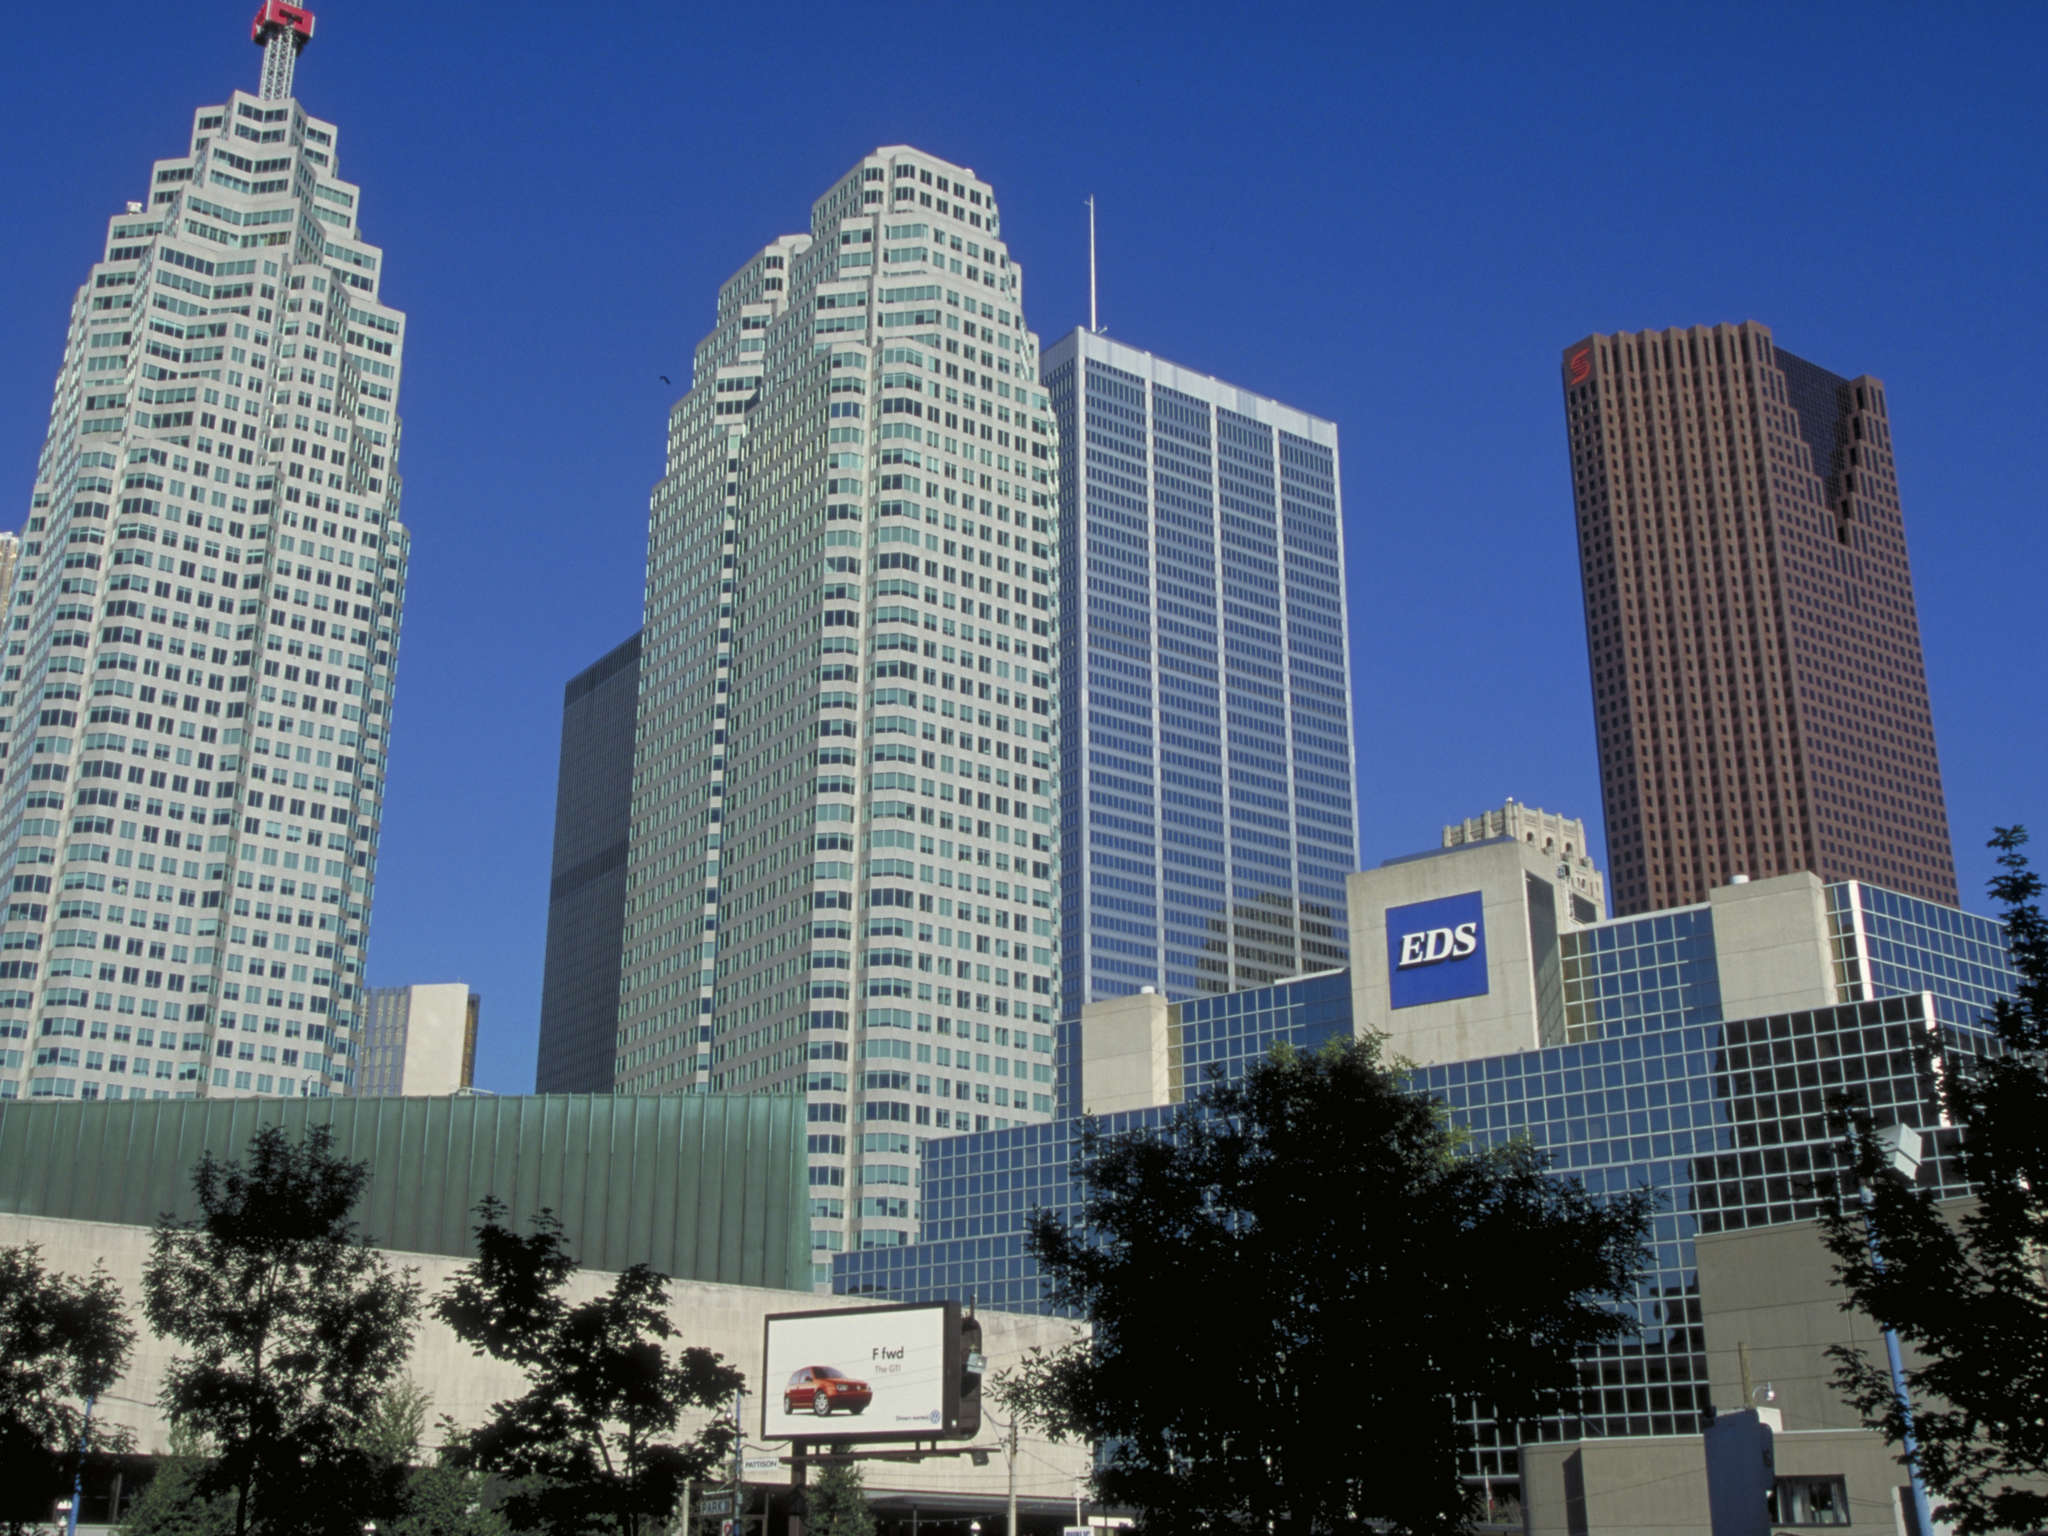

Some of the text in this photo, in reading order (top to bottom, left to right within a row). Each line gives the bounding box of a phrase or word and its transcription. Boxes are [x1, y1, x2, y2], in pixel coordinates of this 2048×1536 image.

[1398, 921, 1477, 966] EDS
[872, 1345, 905, 1361] F fwd
[744, 1460, 778, 1468] PATTISON
